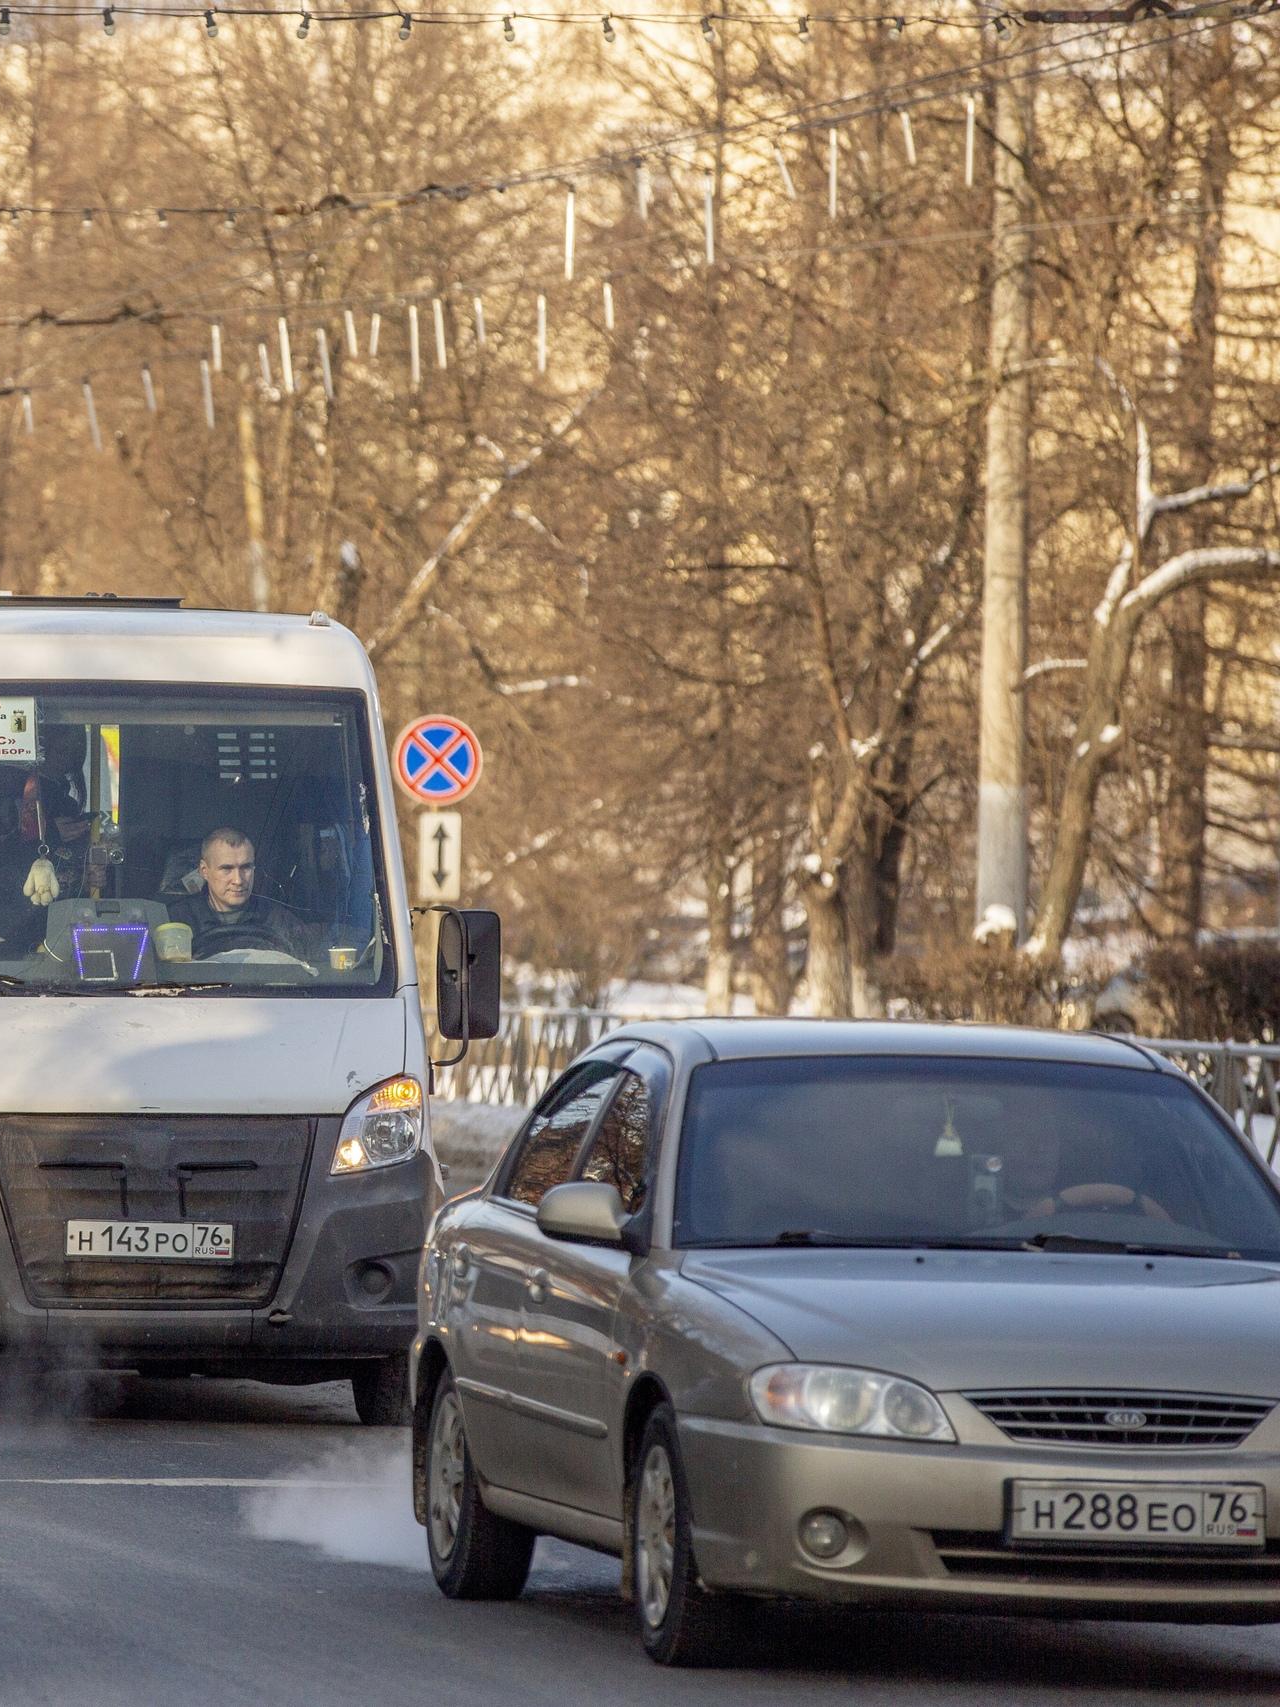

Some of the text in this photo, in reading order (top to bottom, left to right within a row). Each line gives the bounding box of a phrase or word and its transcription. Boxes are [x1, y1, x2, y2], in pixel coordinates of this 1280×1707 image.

[197, 1226, 223, 1247] 76
[194, 1246, 215, 1255] RUS
[1113, 1412, 1141, 1425] KIA
[1208, 1493, 1248, 1523] 76
[1206, 1523, 1237, 1536] RUS
